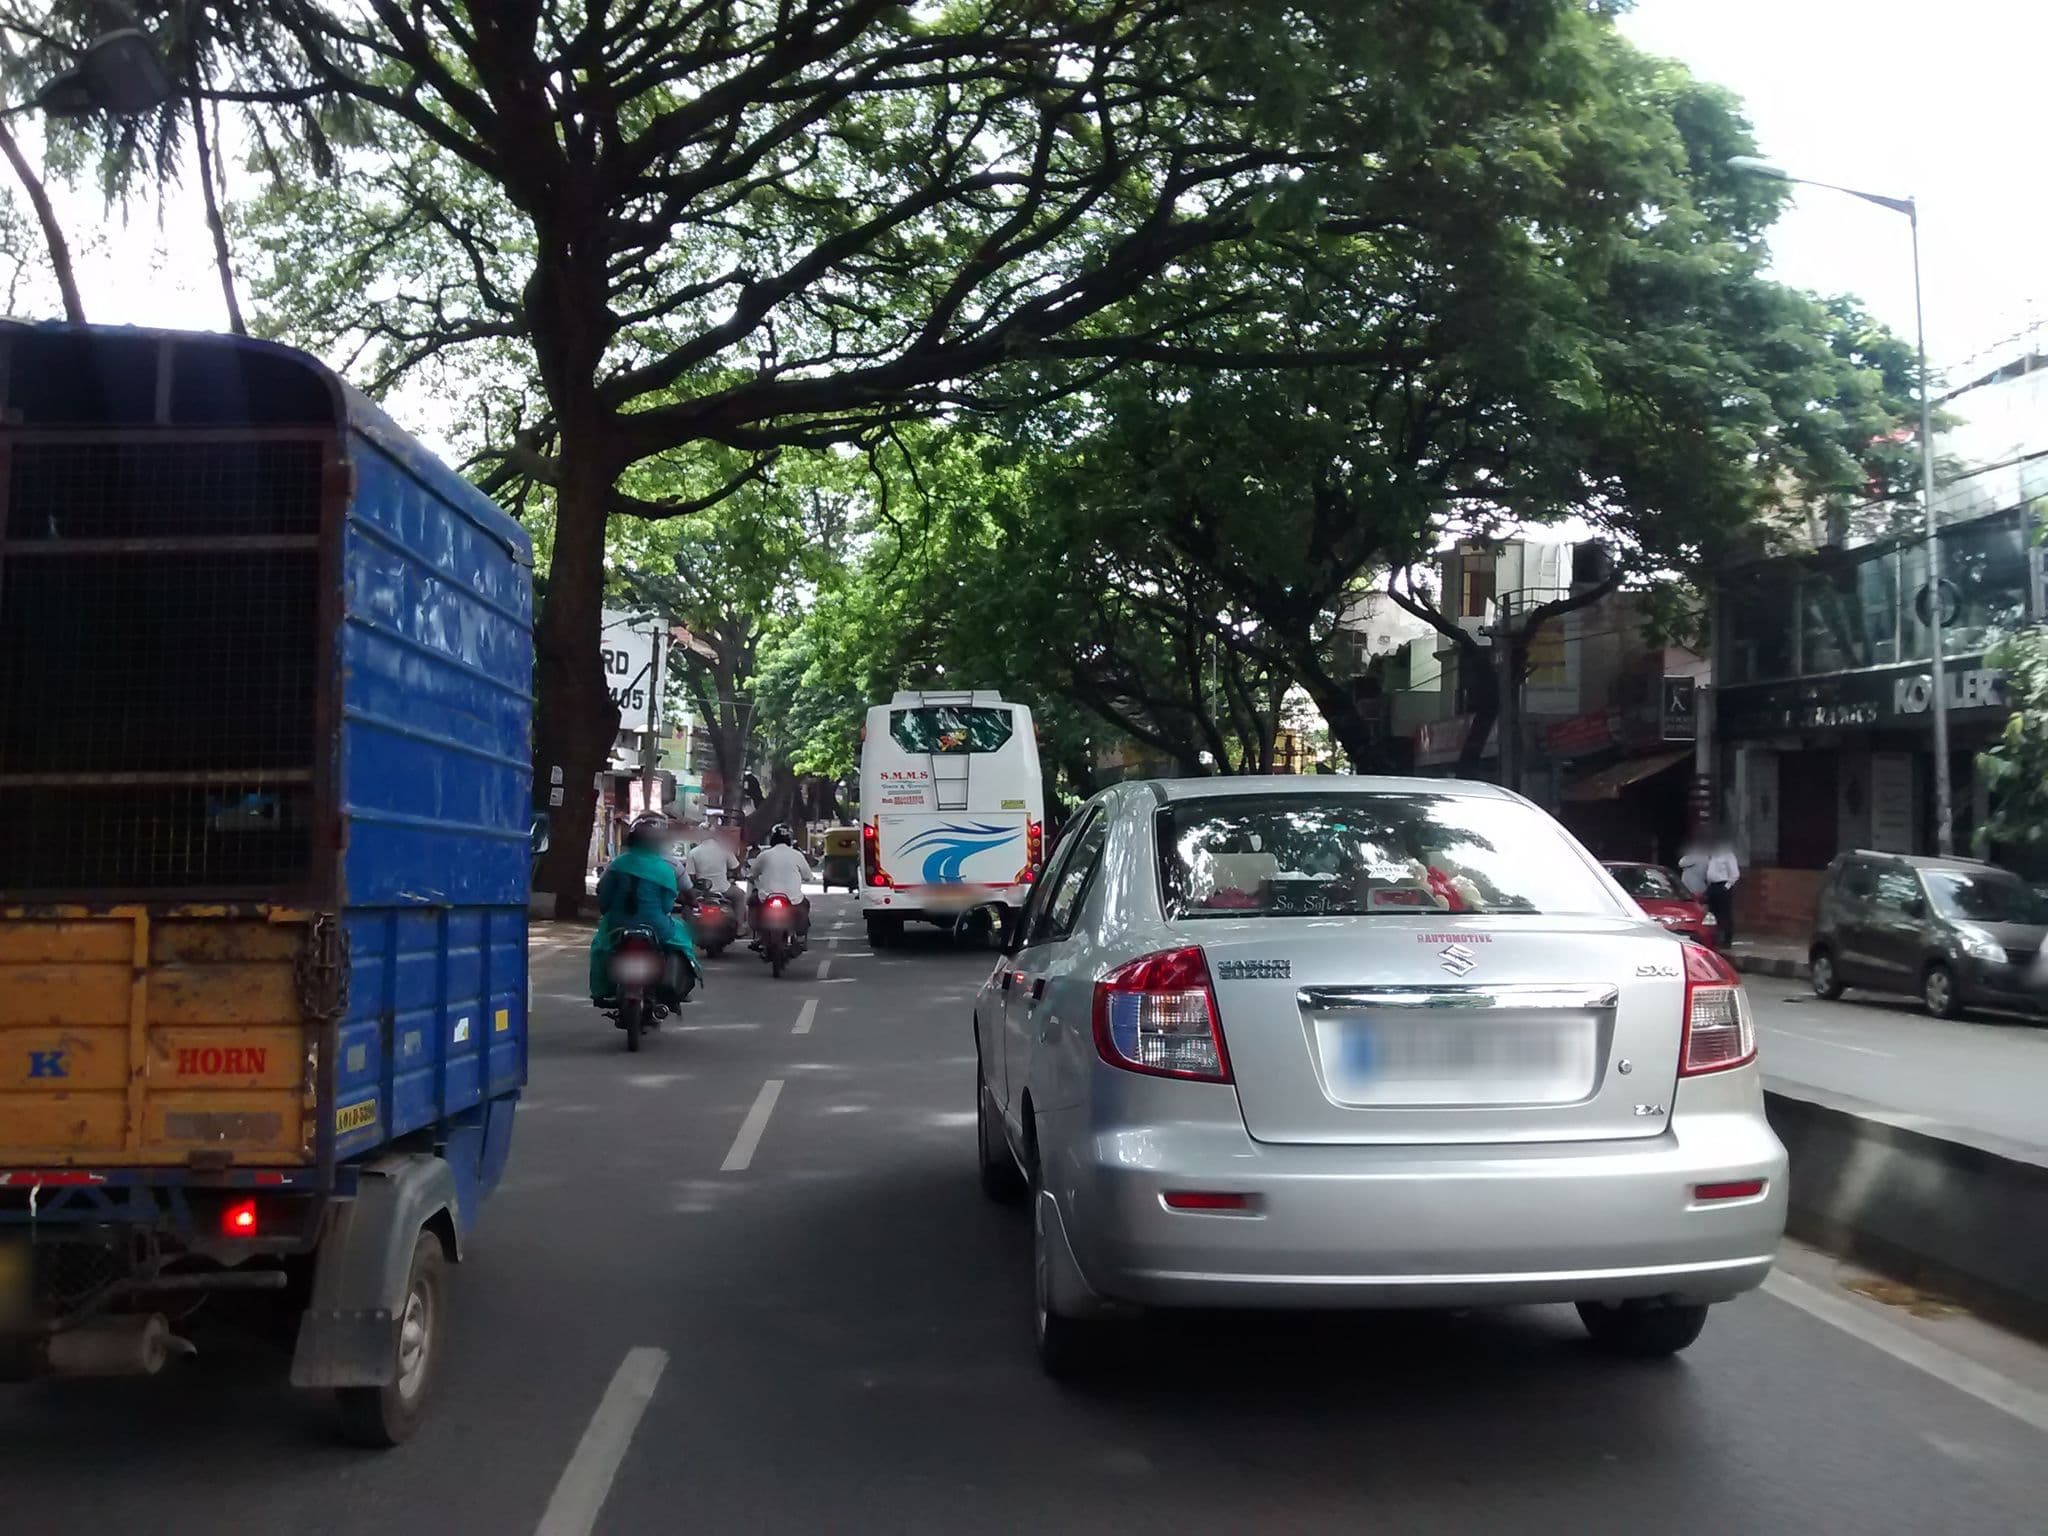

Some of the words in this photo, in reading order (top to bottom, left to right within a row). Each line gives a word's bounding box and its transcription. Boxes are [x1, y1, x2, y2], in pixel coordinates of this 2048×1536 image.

[1894, 668, 2003, 714] KOLER
[28, 1051, 69, 1078] K
[177, 1047, 267, 1075] HORN
